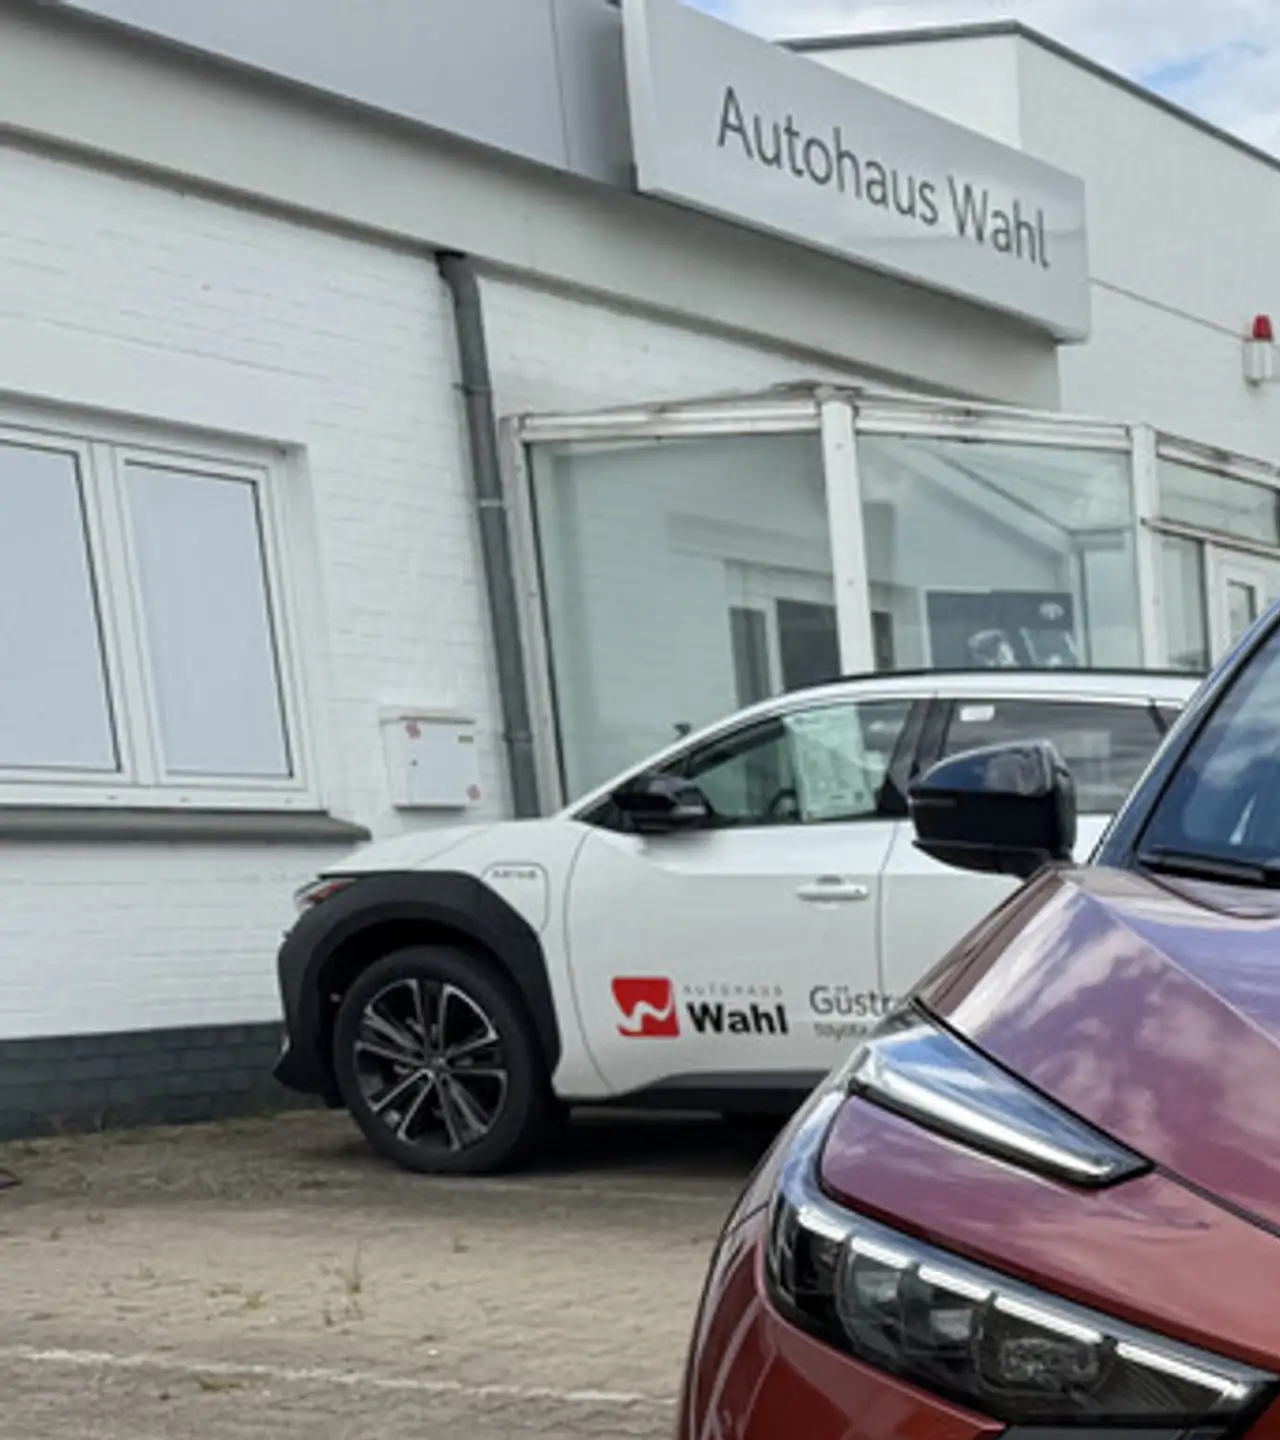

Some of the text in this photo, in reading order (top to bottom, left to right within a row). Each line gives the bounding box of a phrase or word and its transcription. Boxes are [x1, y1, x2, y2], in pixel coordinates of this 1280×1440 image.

[716, 85, 1051, 270] Autohaus Wahl
[686, 1002, 789, 1035] Wahl
